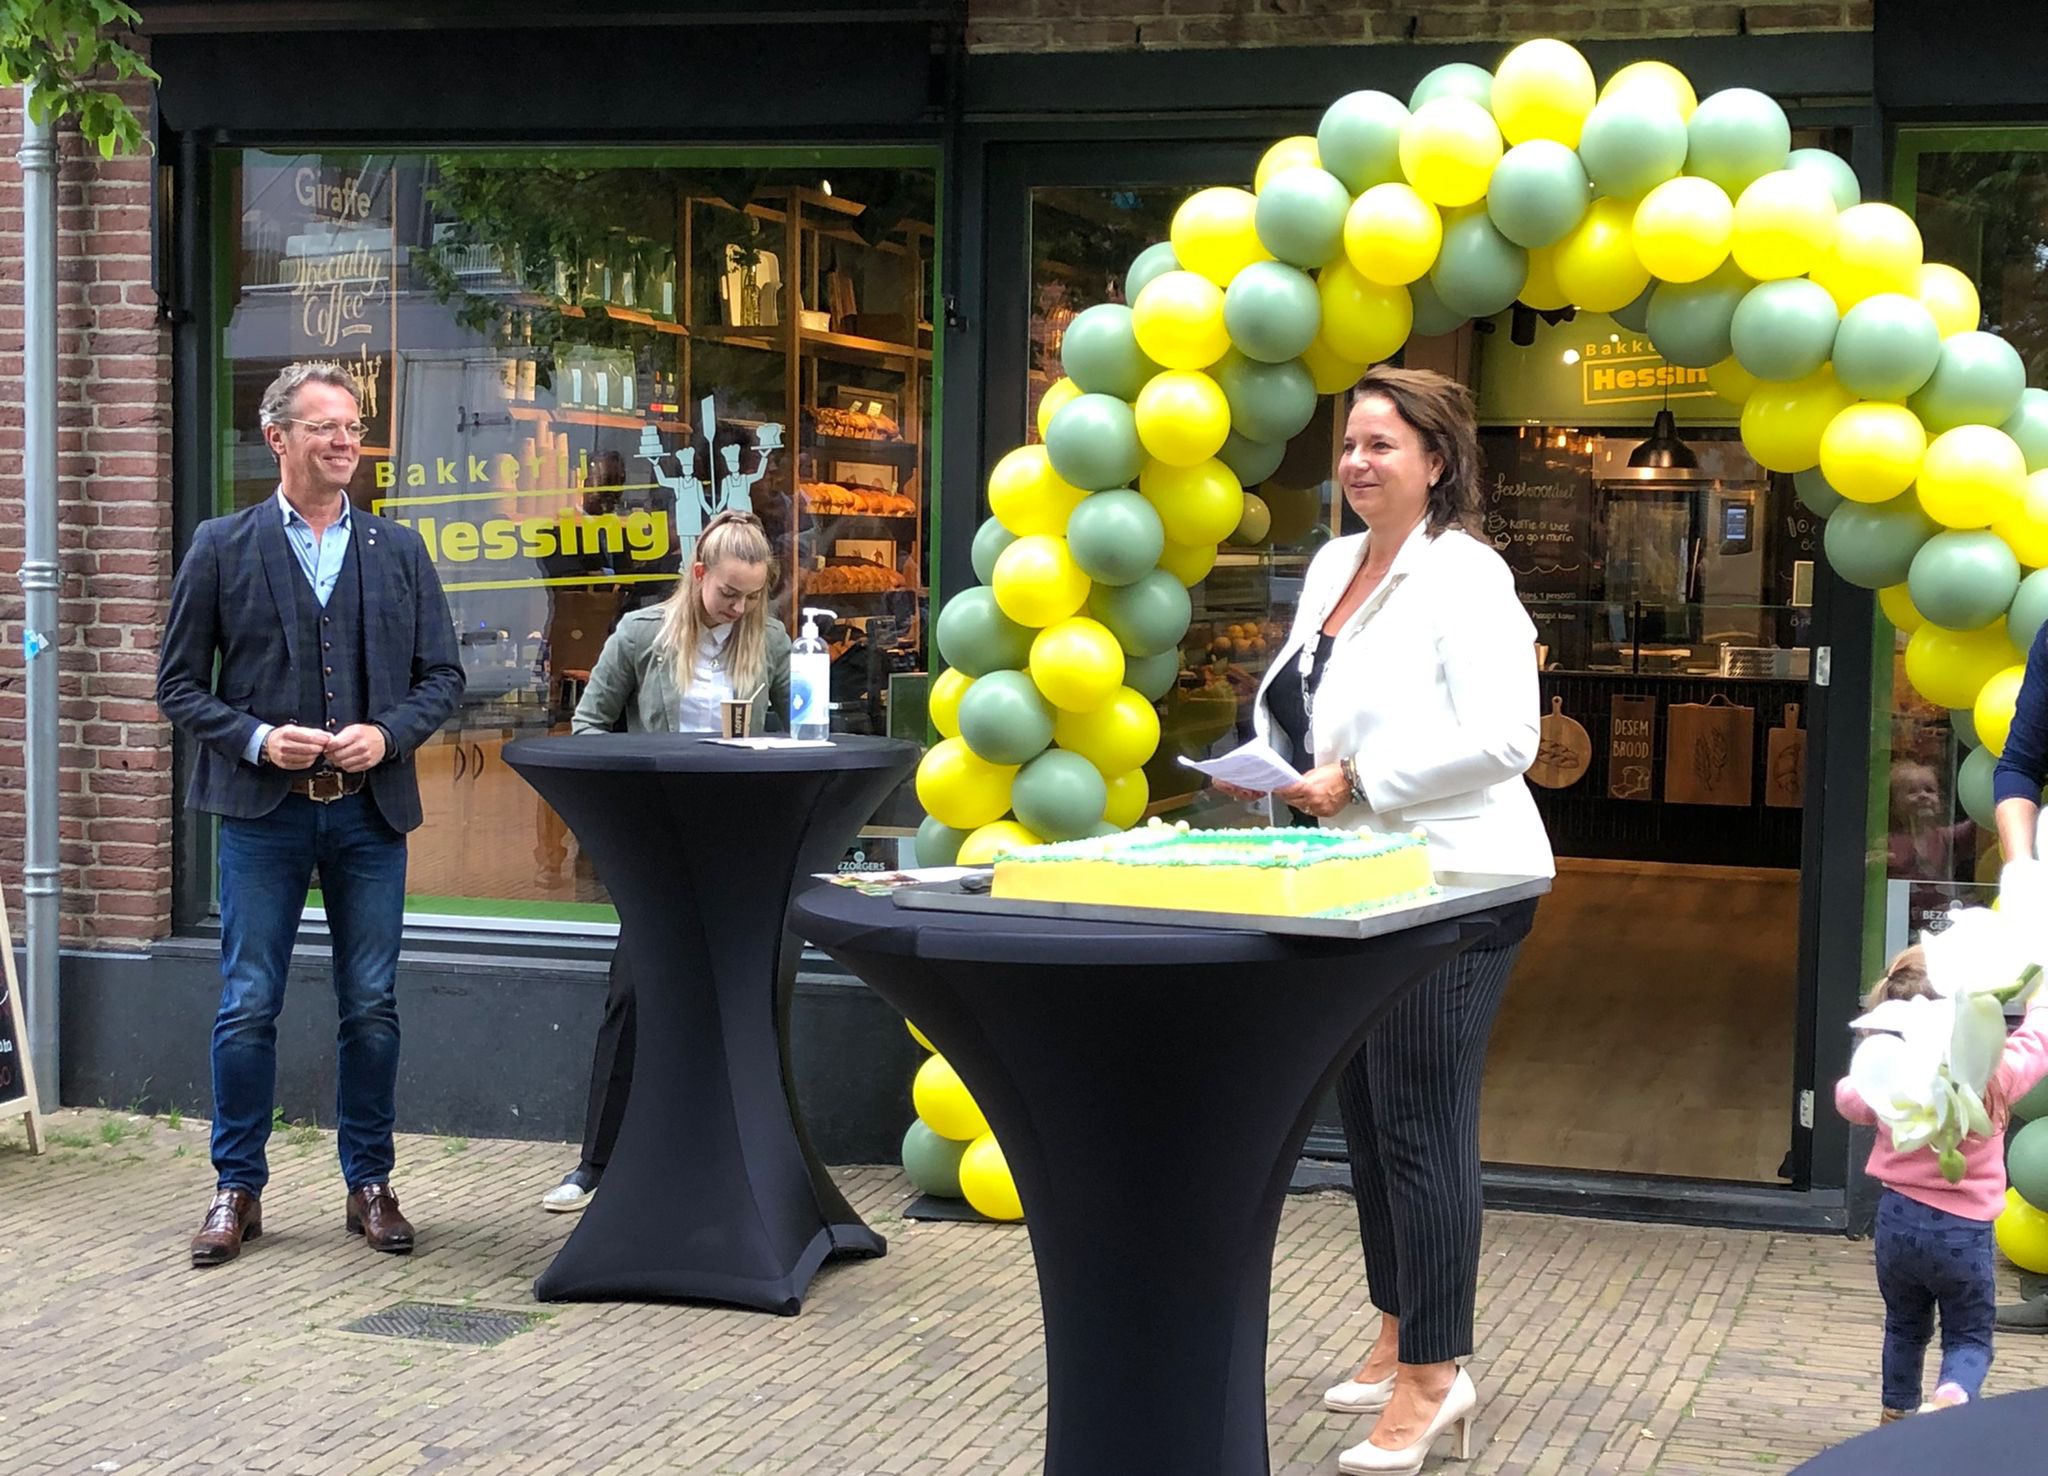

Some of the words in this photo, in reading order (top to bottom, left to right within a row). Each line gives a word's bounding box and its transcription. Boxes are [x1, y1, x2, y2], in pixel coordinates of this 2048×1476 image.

[295, 167, 372, 219] Giraffe
[303, 282, 365, 347] Coffee
[1585, 340, 1656, 356] Bakke
[1593, 367, 1708, 391] Hessin
[374, 448, 590, 489] Bakkerij
[1614, 718, 1649, 737] DESEM
[1613, 740, 1649, 759] BROOD
